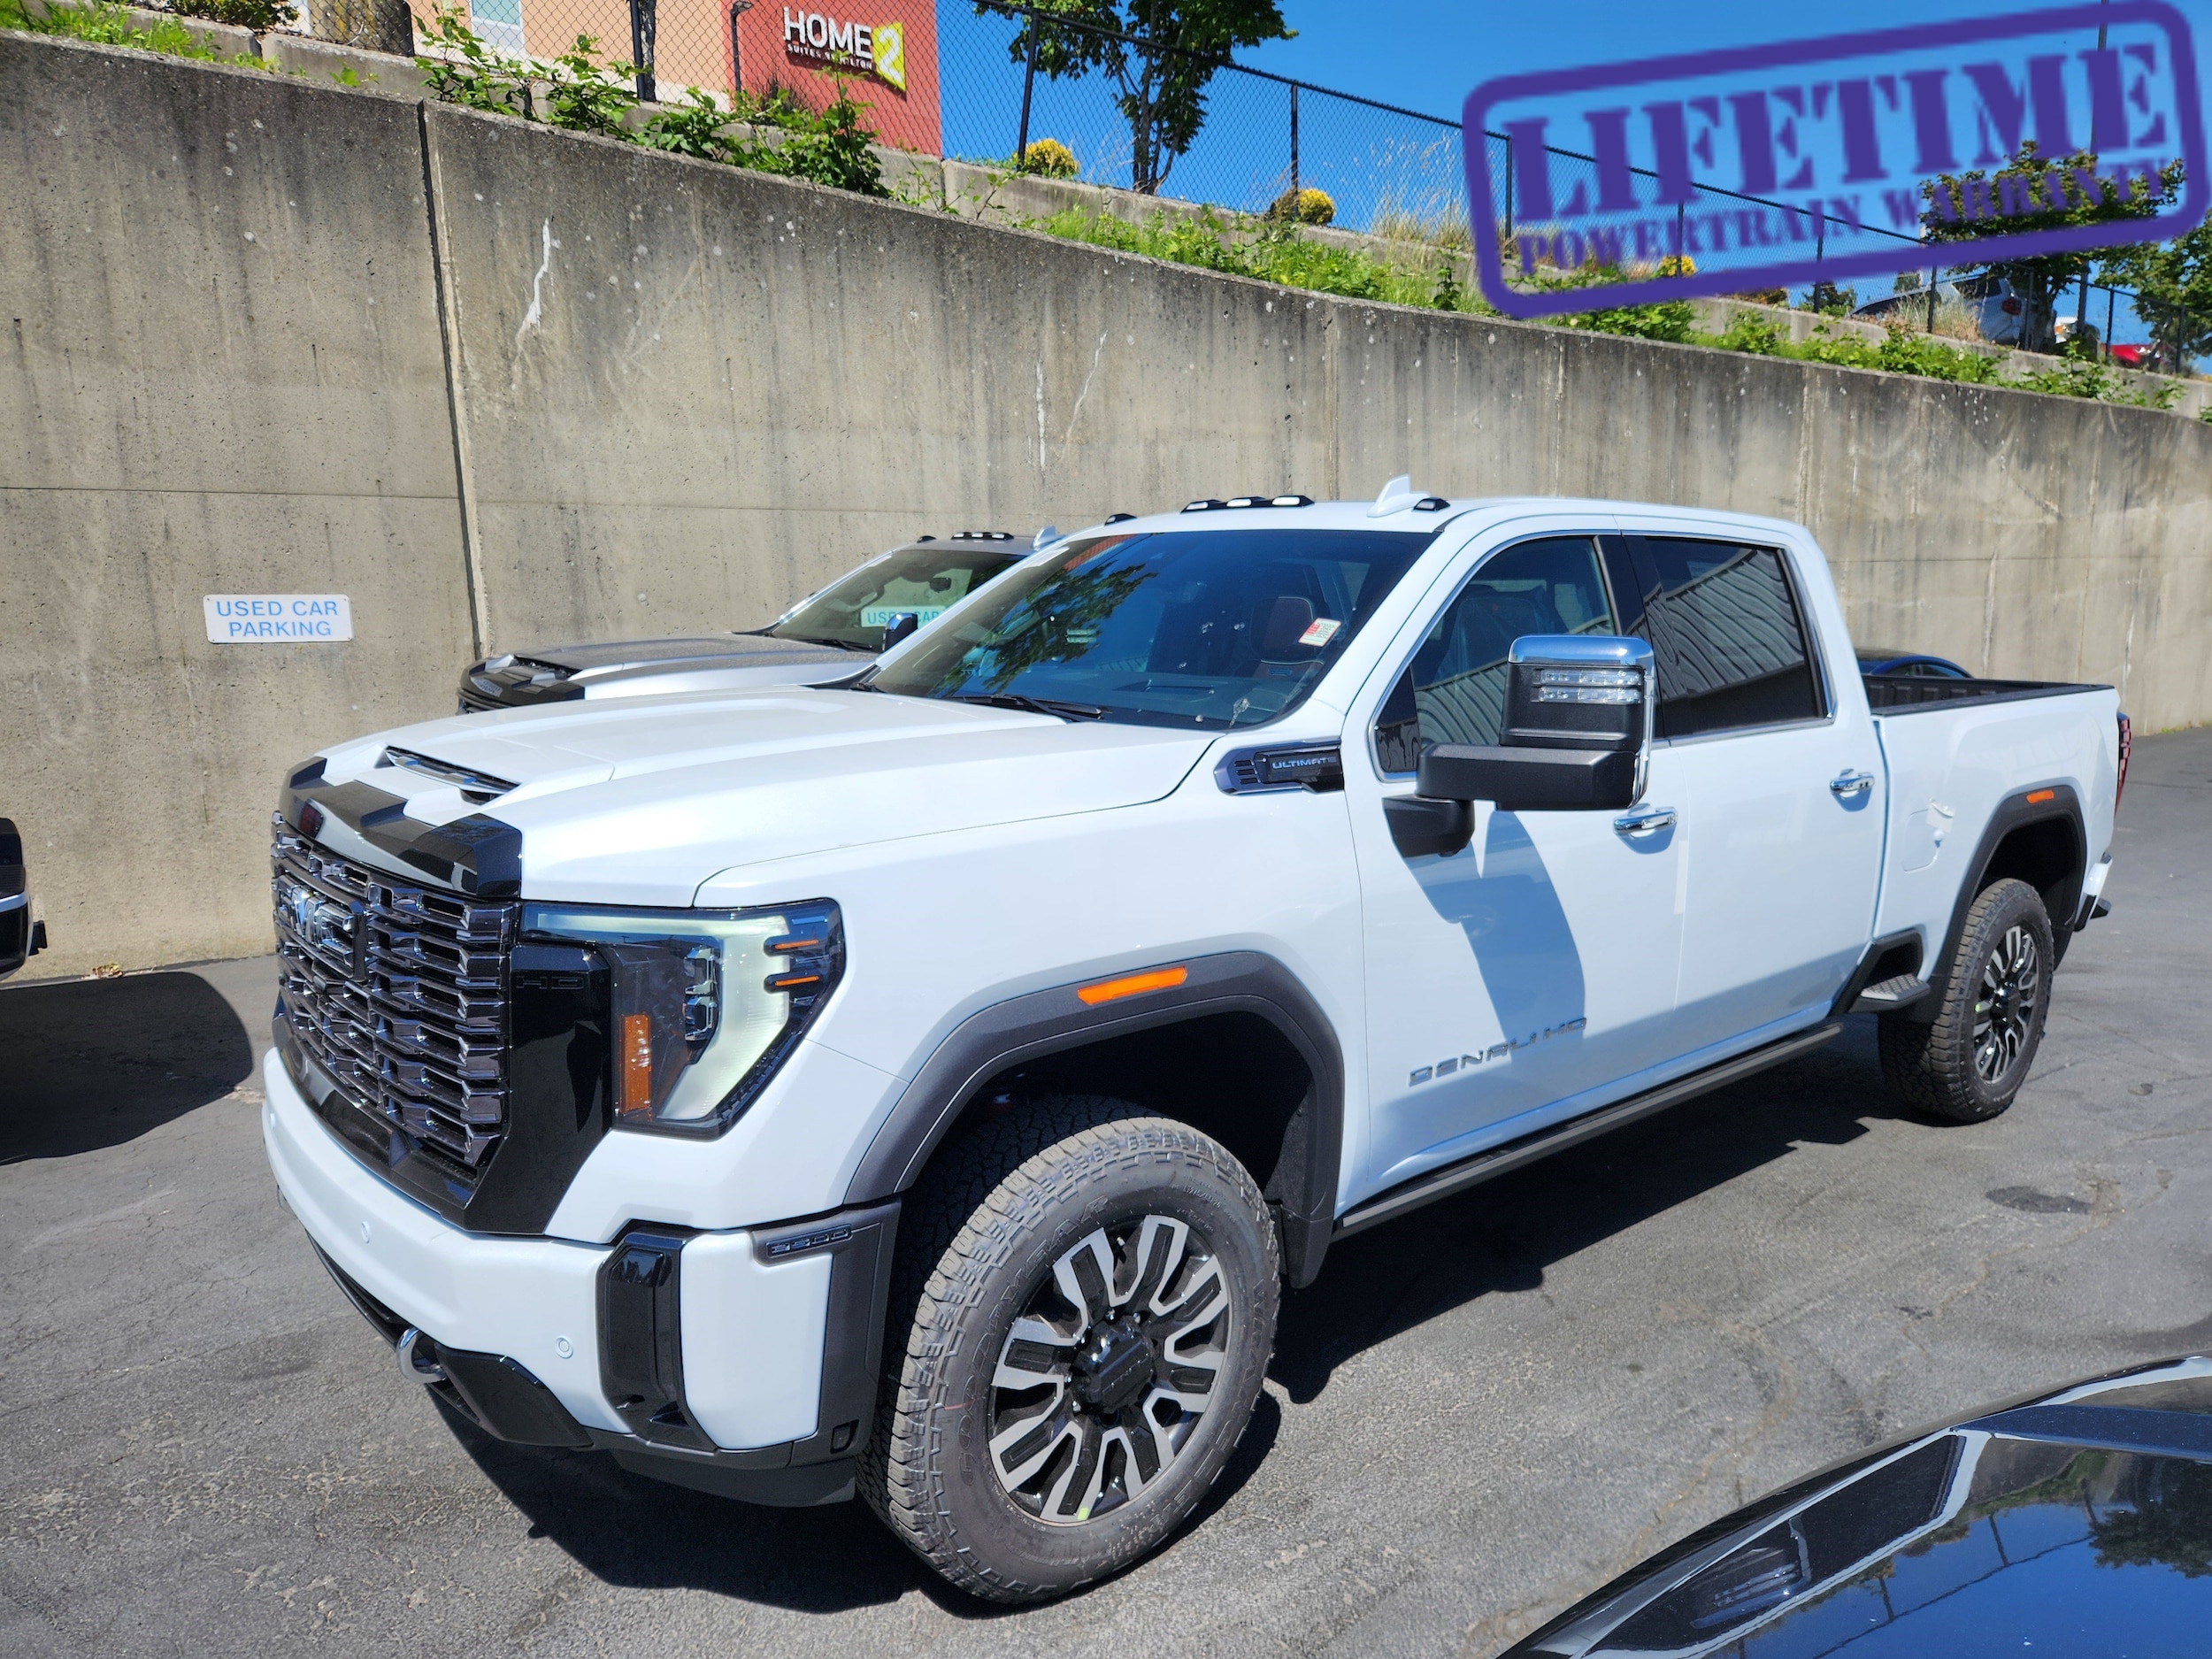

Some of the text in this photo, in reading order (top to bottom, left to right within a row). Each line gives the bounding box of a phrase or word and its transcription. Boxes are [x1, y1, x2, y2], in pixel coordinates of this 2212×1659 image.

[216, 600, 338, 617] USED CAR
[228, 620, 332, 637] PARKING
[1271, 756, 1338, 769] ULTIMATE
